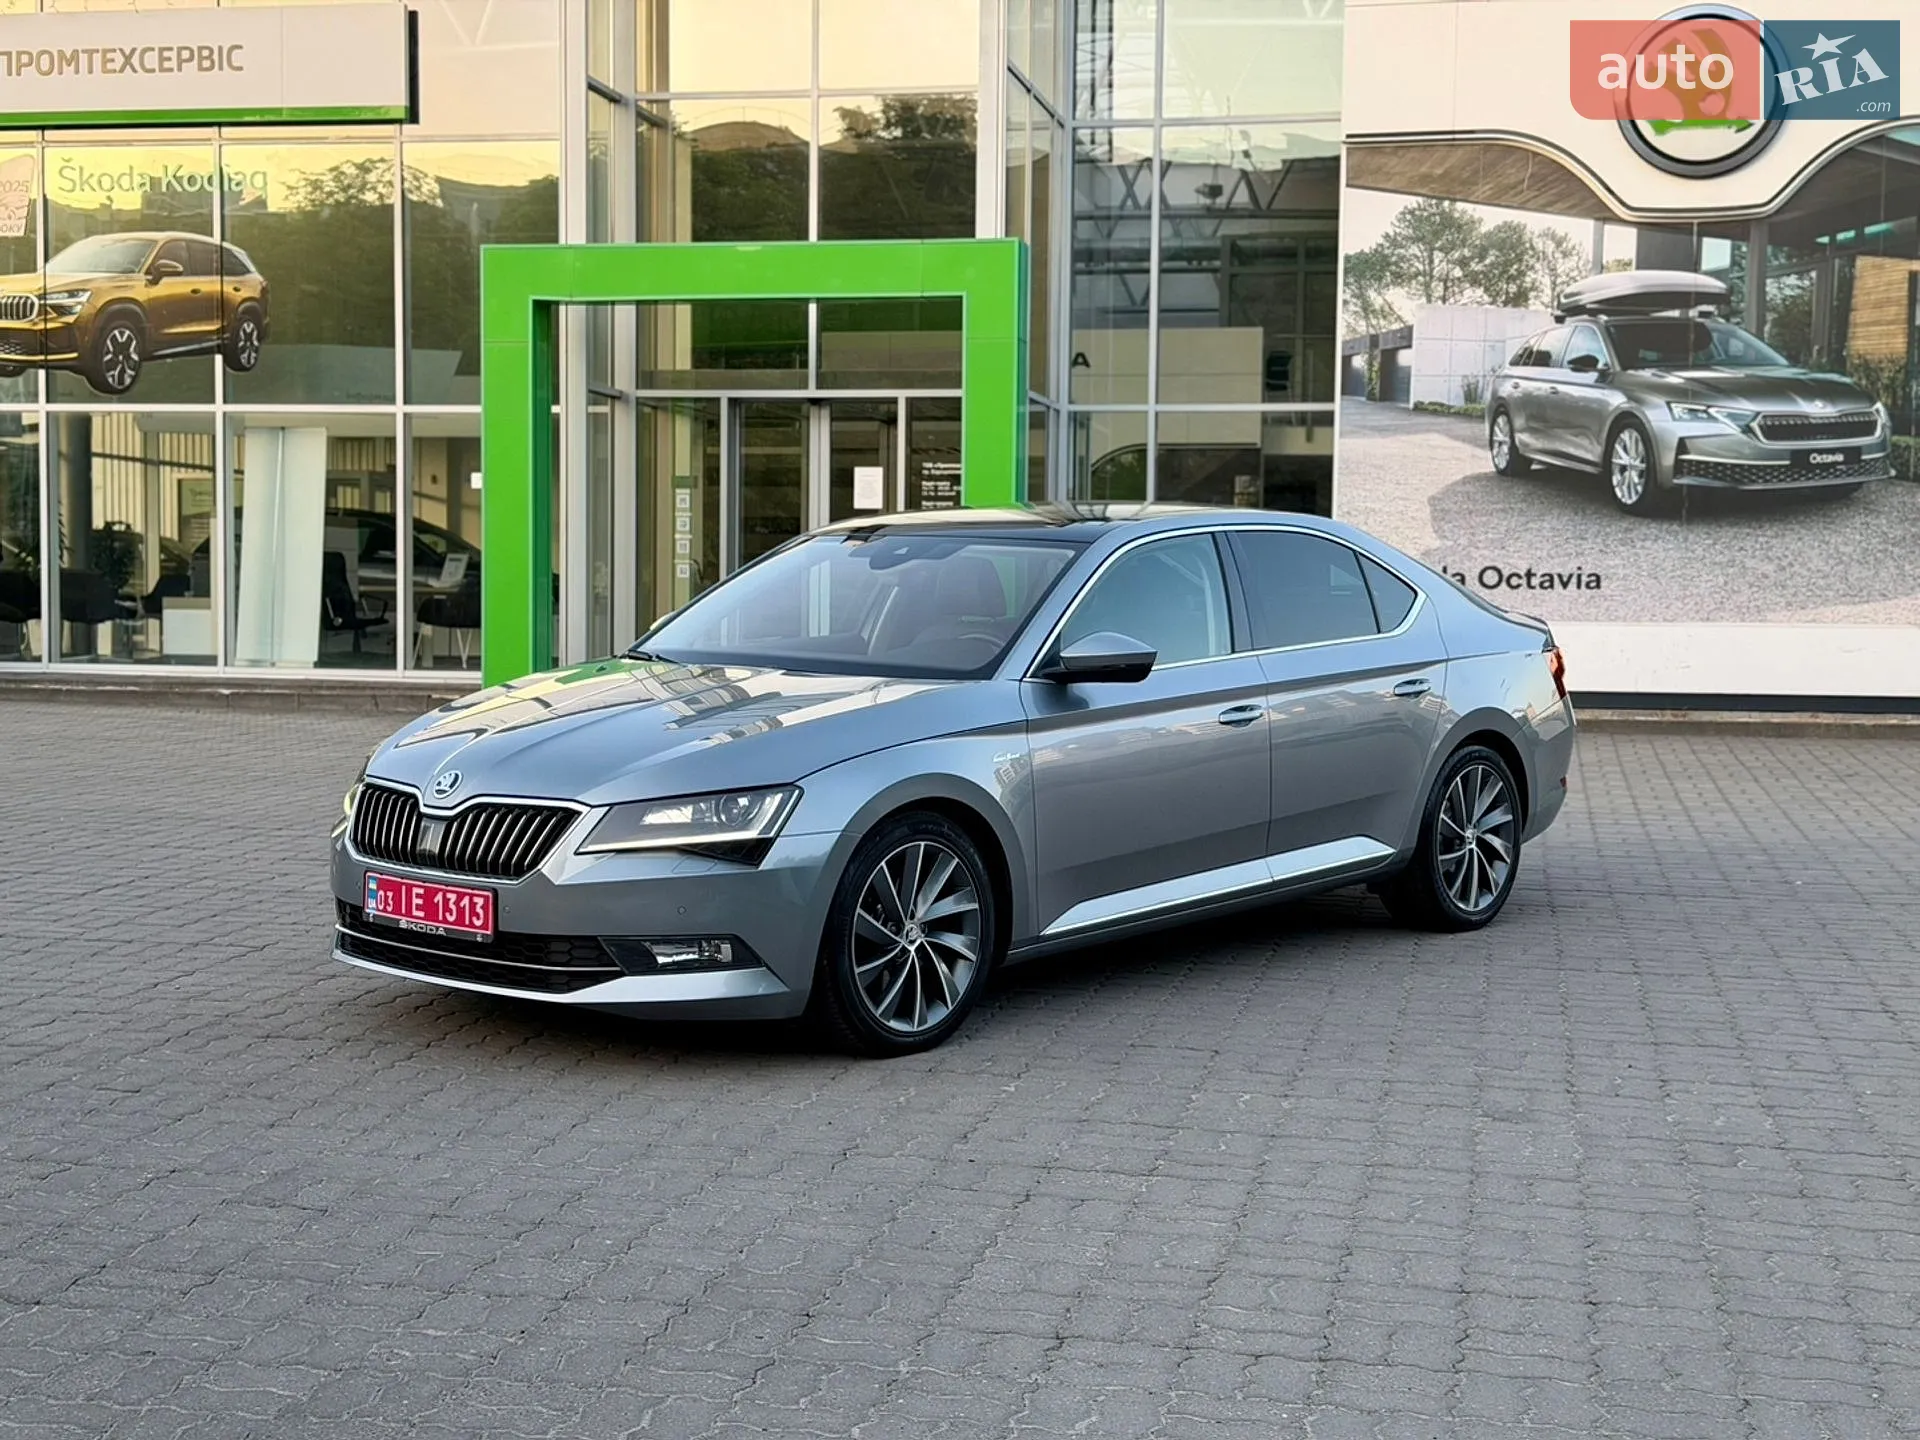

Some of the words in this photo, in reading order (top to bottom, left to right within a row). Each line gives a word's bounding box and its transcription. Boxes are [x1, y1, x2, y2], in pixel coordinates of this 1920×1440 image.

[58, 157, 151, 193] Škoda
[161, 164, 268, 199] Kodiaq
[1809, 452, 1845, 464] Octavia
[1478, 565, 1601, 590] Octavia
[377, 890, 394, 912] 03
[401, 885, 425, 918] IE
[433, 891, 485, 926] 1313
